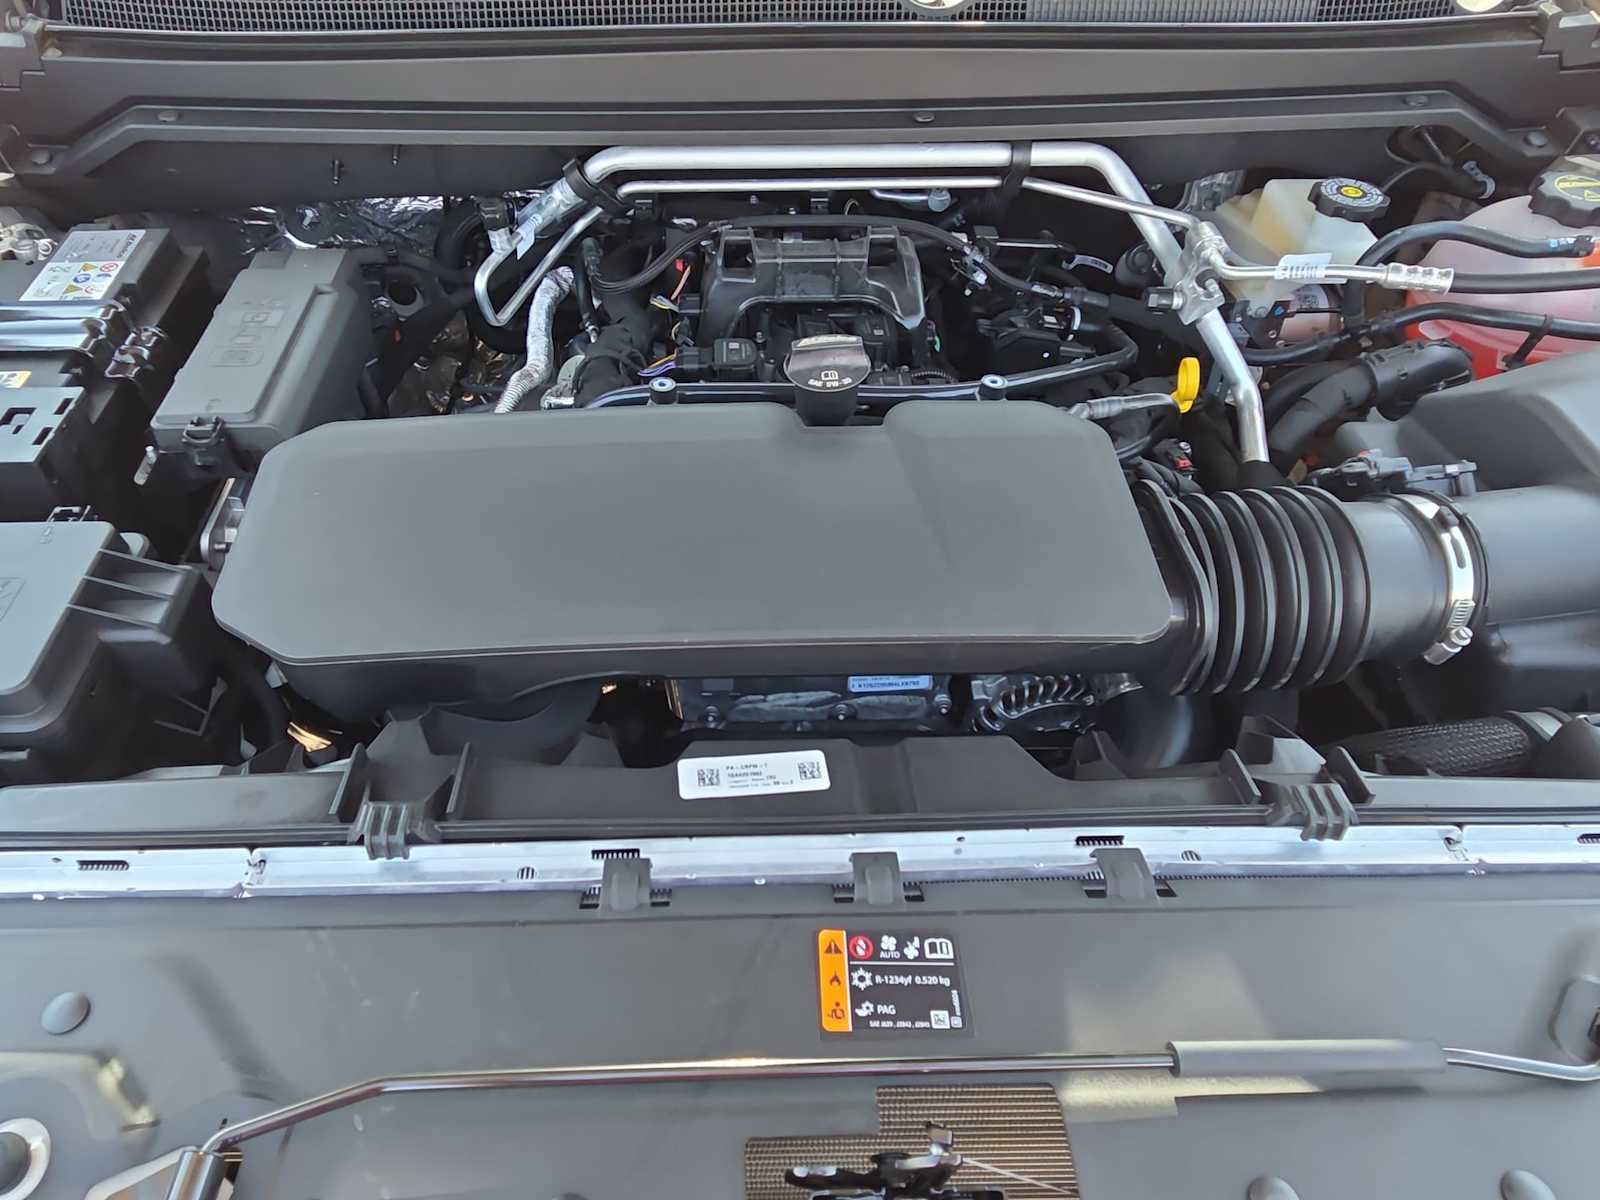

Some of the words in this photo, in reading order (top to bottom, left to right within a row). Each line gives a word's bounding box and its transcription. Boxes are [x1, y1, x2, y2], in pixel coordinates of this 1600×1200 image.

[875, 975, 912, 986] R-1234yf
[915, 975, 938, 984] 0.520
[939, 975, 950, 986] kg
[877, 1004, 896, 1015] PAG
